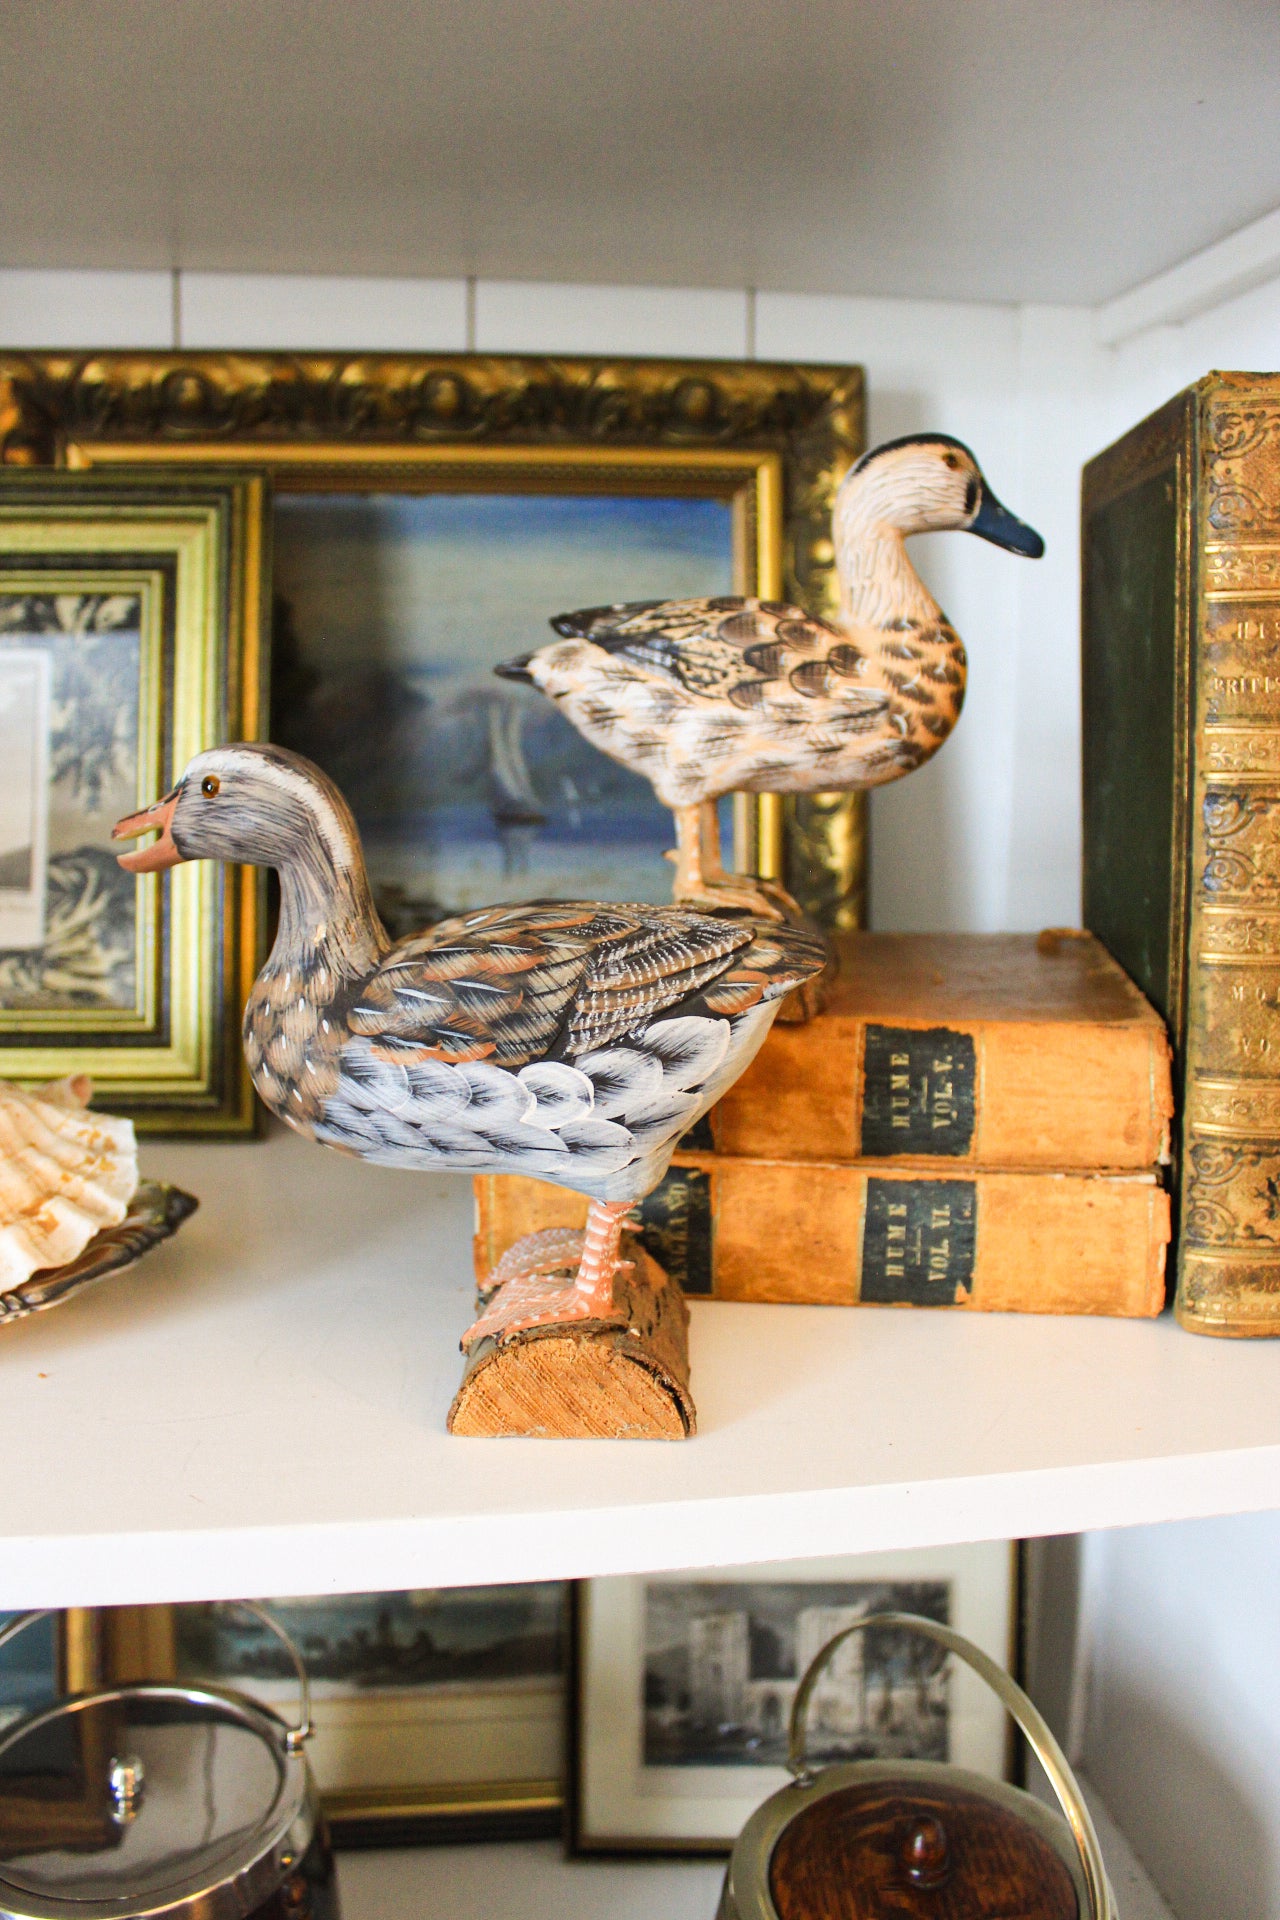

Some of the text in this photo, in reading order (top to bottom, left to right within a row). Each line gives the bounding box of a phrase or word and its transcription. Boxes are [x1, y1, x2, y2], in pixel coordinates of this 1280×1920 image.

[1232, 986, 1280, 1002] MO
[890, 1053, 910, 1128] HUME
[885, 1203, 907, 1277] HUME
[928, 1204, 950, 1281] VOL. VI.
